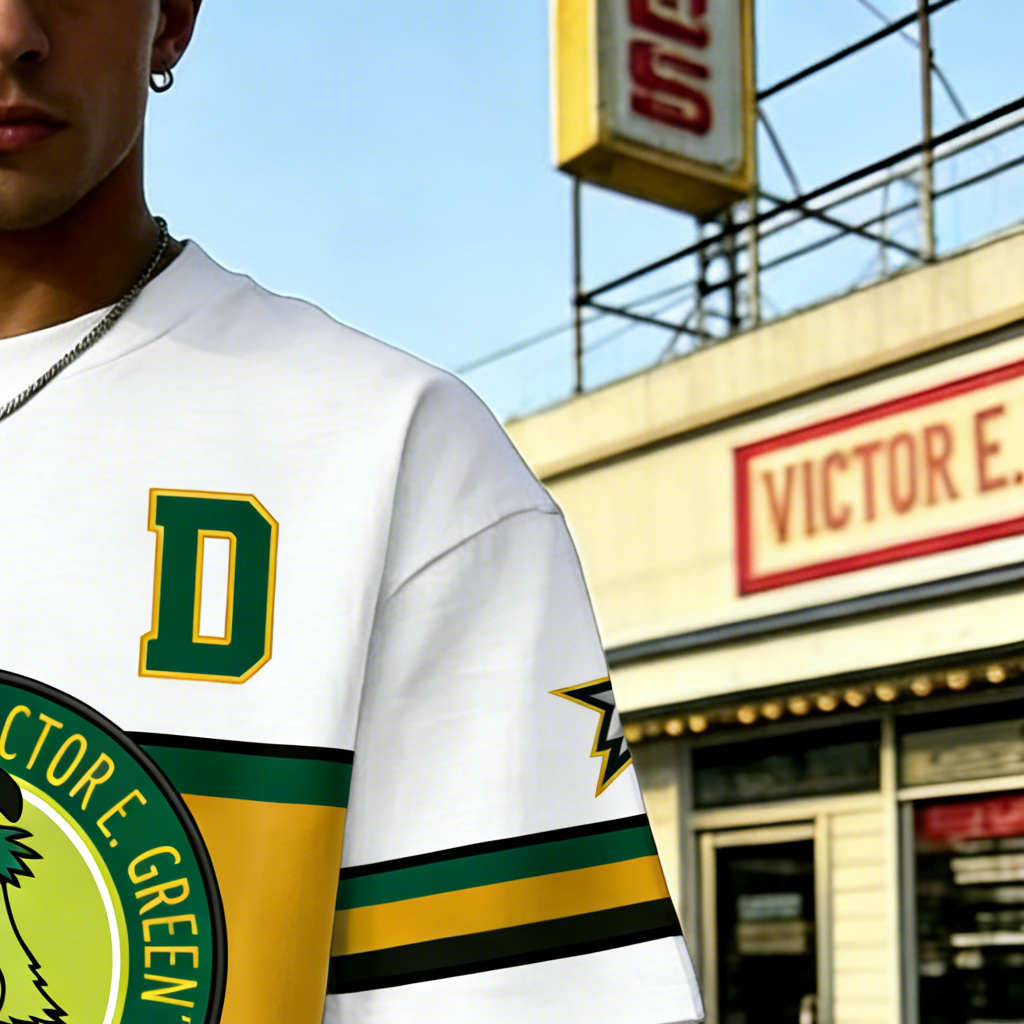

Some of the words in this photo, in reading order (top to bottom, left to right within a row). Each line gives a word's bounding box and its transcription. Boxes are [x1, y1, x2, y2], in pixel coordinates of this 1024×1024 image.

[763, 423, 959, 544] VICTOR
[138, 487, 279, 685] D
[96, 789, 147, 848] E.
